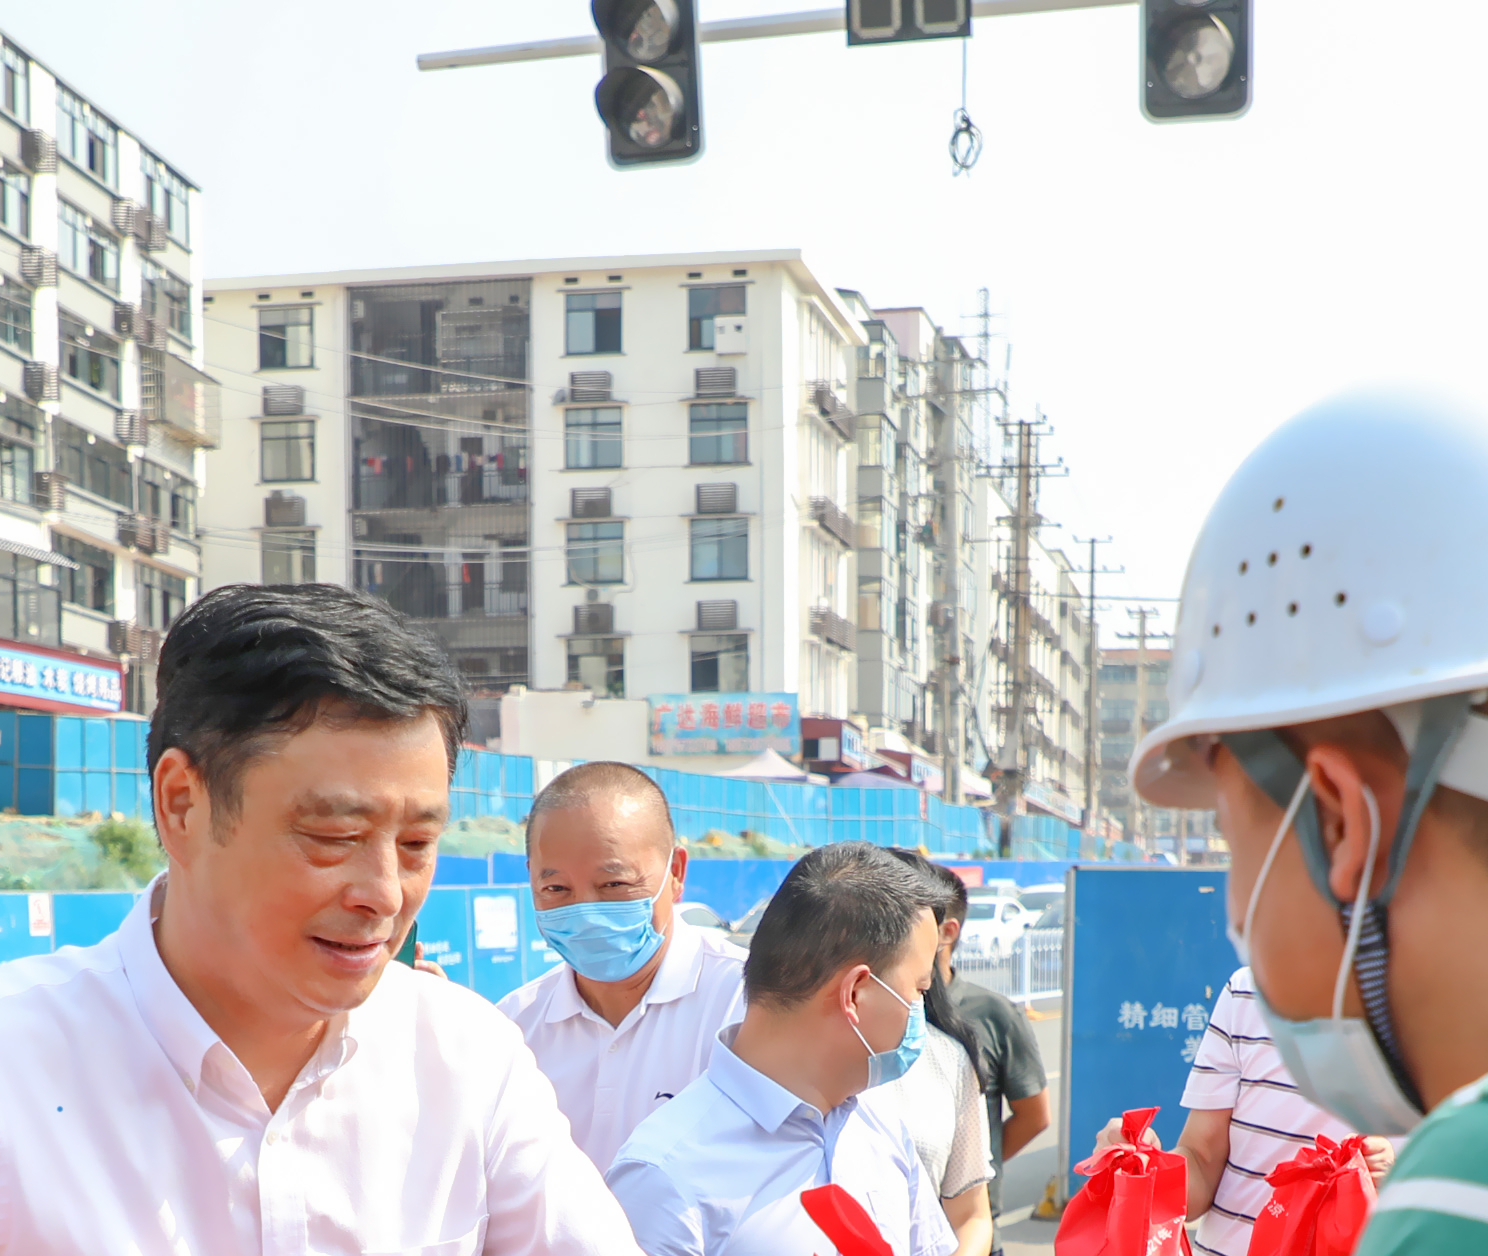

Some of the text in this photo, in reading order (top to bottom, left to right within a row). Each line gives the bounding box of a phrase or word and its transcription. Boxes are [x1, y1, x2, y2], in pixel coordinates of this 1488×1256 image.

[653, 702, 792, 730] 广达海鲜超市
